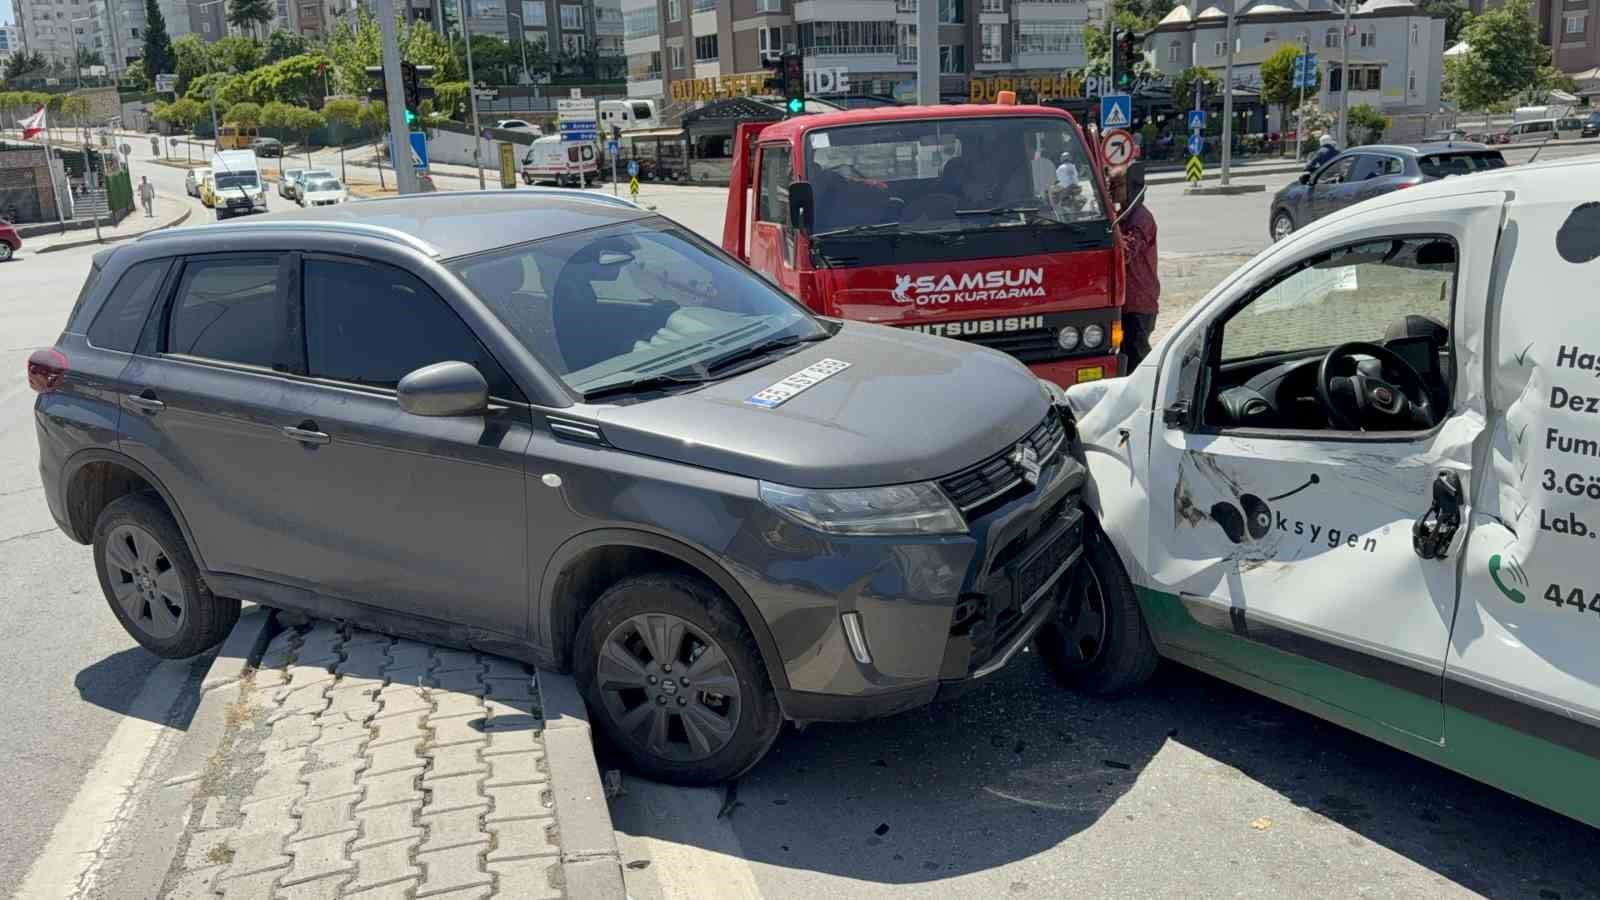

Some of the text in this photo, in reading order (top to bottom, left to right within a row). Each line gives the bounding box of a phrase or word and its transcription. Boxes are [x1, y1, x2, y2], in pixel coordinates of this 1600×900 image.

[915, 267, 1044, 293] SAMSUN
[915, 286, 1046, 305] OTO KURTARMA
[1540, 509, 1596, 538] Lab.
